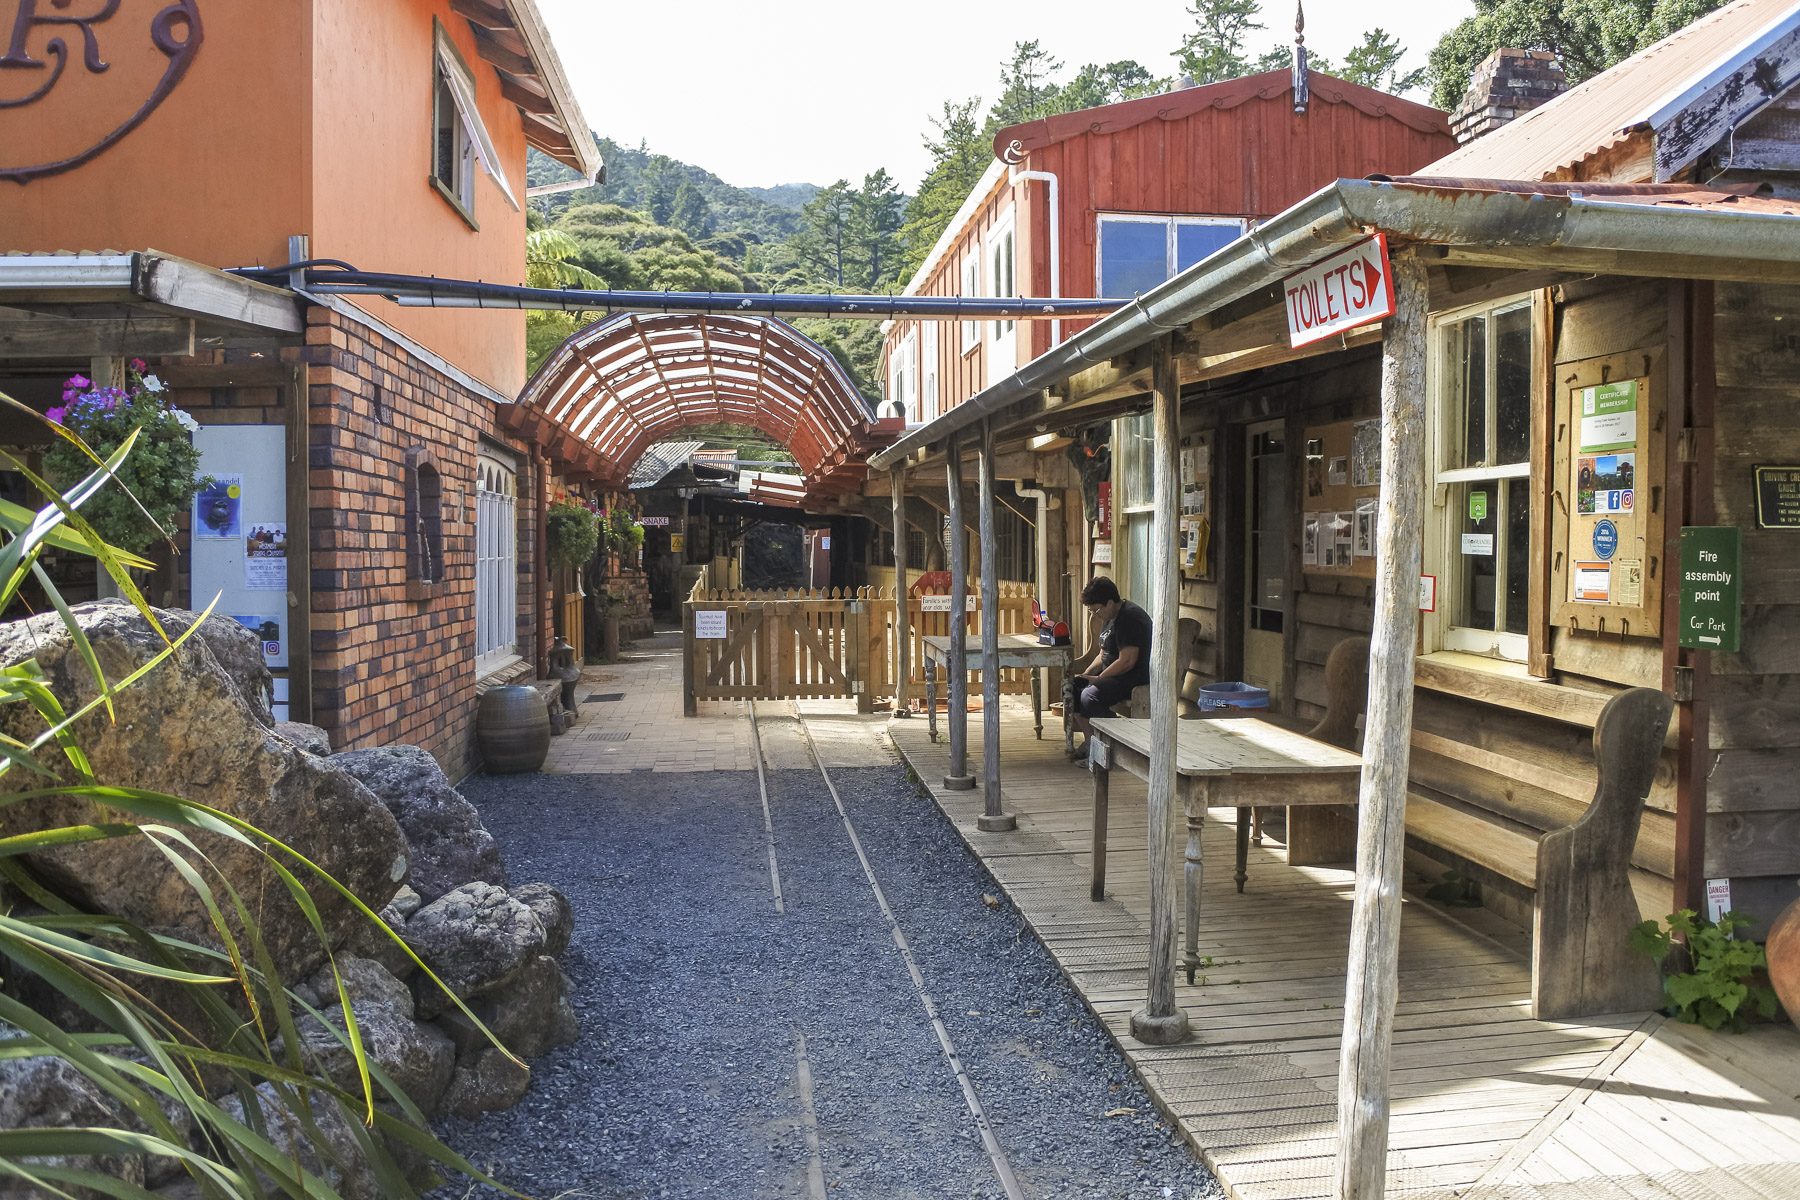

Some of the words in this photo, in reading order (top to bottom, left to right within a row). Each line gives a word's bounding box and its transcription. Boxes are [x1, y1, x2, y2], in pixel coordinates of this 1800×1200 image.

[1287, 259, 1367, 333] TOILETS
[1600, 399, 1629, 409] MEMBERSHIP
[643, 517, 668, 525] SNAKE
[1698, 550, 1718, 562] Fire
[1685, 570, 1731, 585] assembly
[968, 596, 974, 604] 4
[1694, 590, 1720, 602] point
[1690, 616, 1704, 629] Car
[1708, 617, 1726, 631] Park
[1203, 699, 1227, 708] PLEASE
[1708, 886, 1728, 894] DANGER
